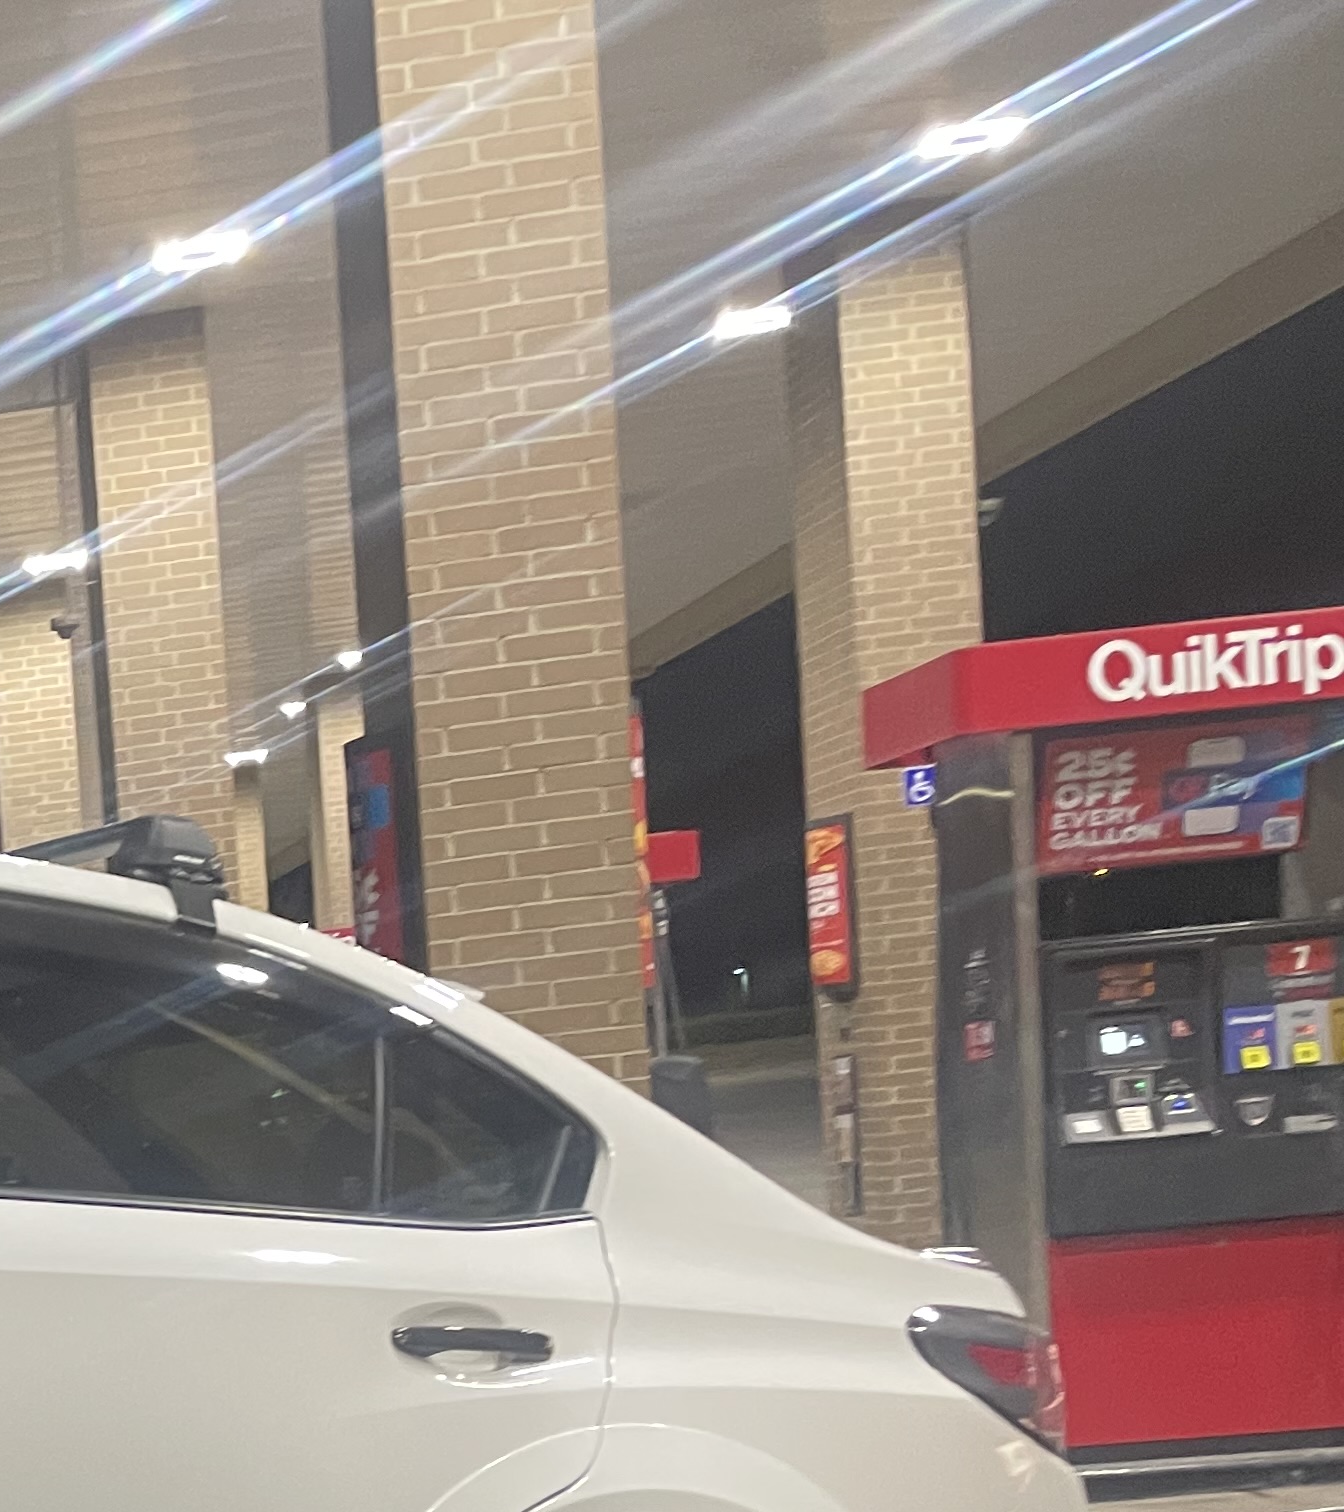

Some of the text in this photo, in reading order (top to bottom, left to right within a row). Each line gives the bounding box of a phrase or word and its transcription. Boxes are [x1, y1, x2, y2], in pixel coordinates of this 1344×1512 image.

[1087, 624, 1344, 702] QuikTrip
[1055, 747, 1137, 782] 25¢
[1054, 776, 1138, 811] OFF
[1051, 803, 1145, 831] EVERY
[1049, 822, 1163, 851] GALLON
[1289, 944, 1311, 971] 7
